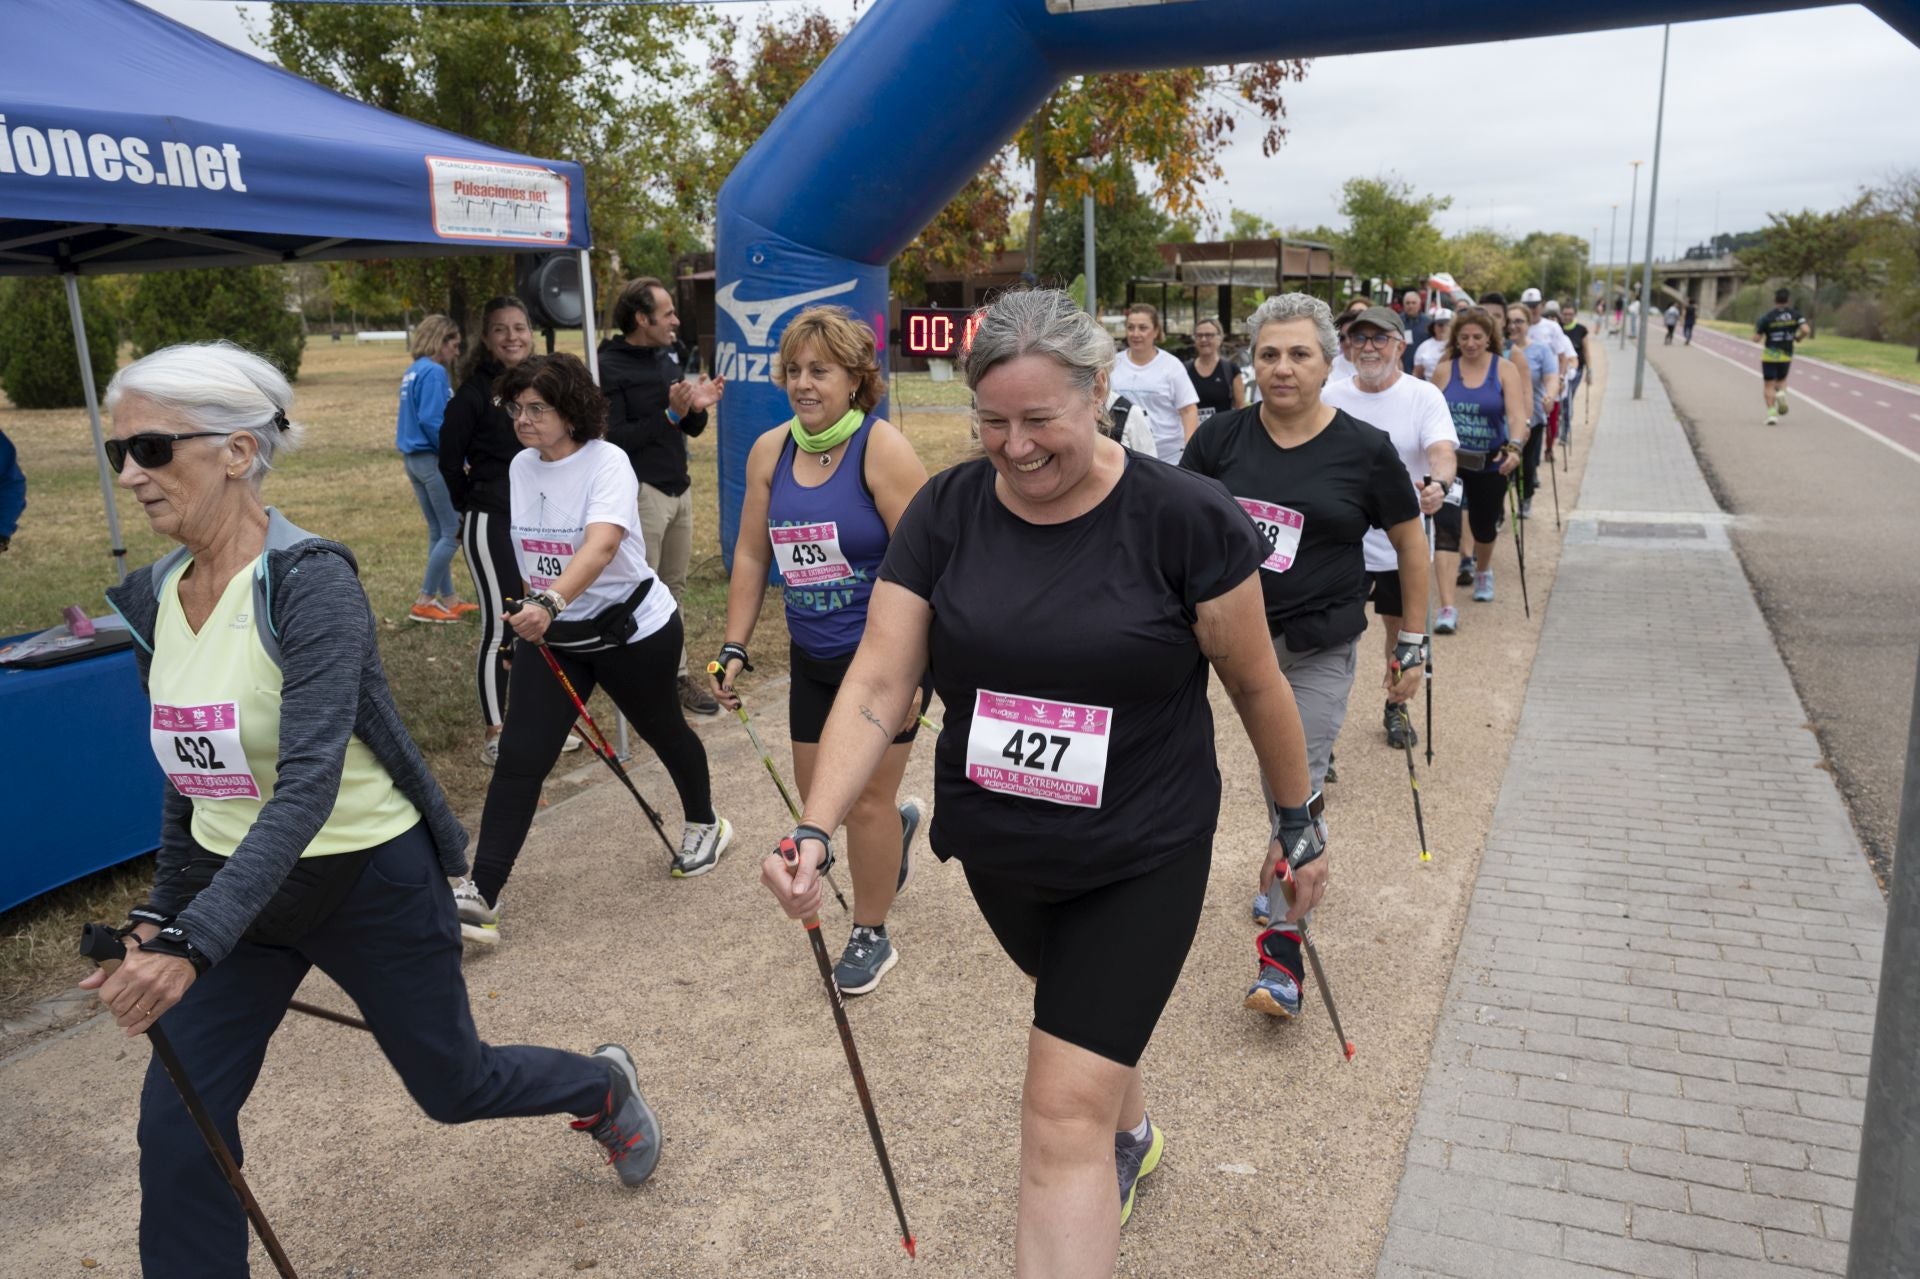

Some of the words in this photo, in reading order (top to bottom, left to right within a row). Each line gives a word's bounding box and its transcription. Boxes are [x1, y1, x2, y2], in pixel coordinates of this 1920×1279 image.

[453, 180, 549, 204] Pulsaciones.net
[537, 555, 562, 577] 439
[792, 543, 827, 566] 433
[808, 565, 845, 576] EXTREMADURA
[174, 736, 226, 769] 432
[1002, 729, 1071, 773] 427
[173, 775, 194, 786] JUNTA
[203, 776, 253, 787] EXTREMADURA
[976, 766, 1004, 781] JUNTA
[1008, 772, 1019, 782] DE
[1023, 775, 1091, 797] EXTREMADURA
[1292, 838, 1308, 860] LEKI
